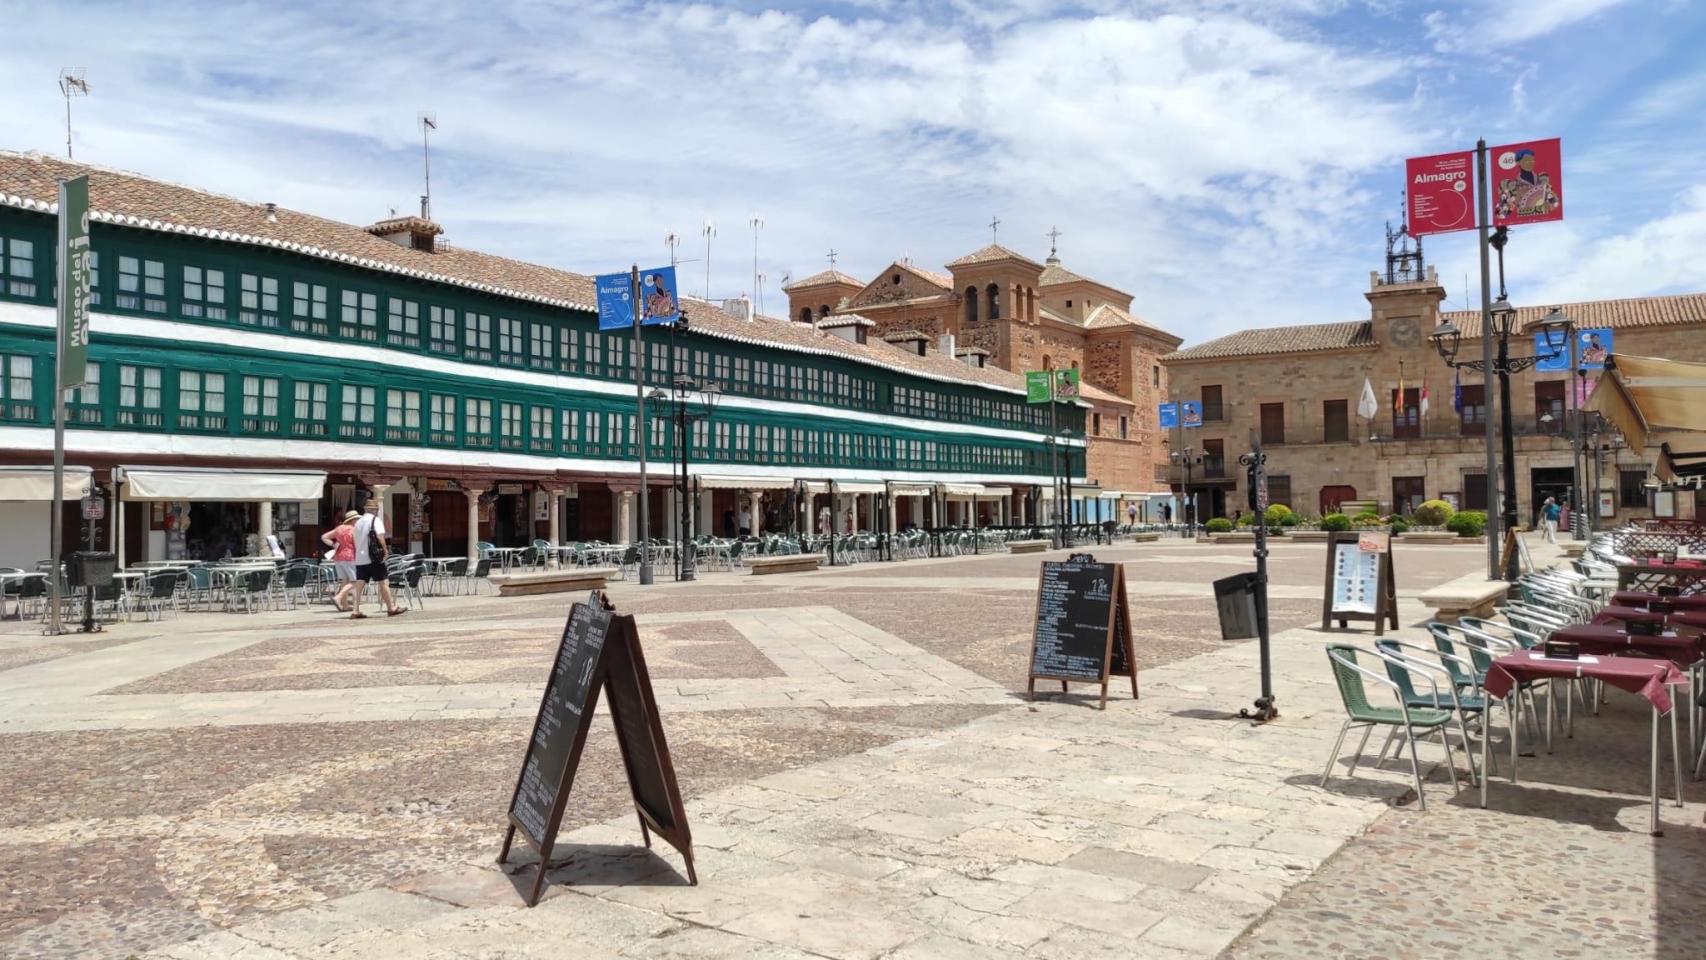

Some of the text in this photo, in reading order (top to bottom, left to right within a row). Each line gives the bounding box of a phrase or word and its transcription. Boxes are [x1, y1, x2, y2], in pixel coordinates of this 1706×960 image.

[1414, 171, 1466, 184] Almagro
[600, 286, 629, 294] Almagro
[71, 253, 81, 346] Museo del
